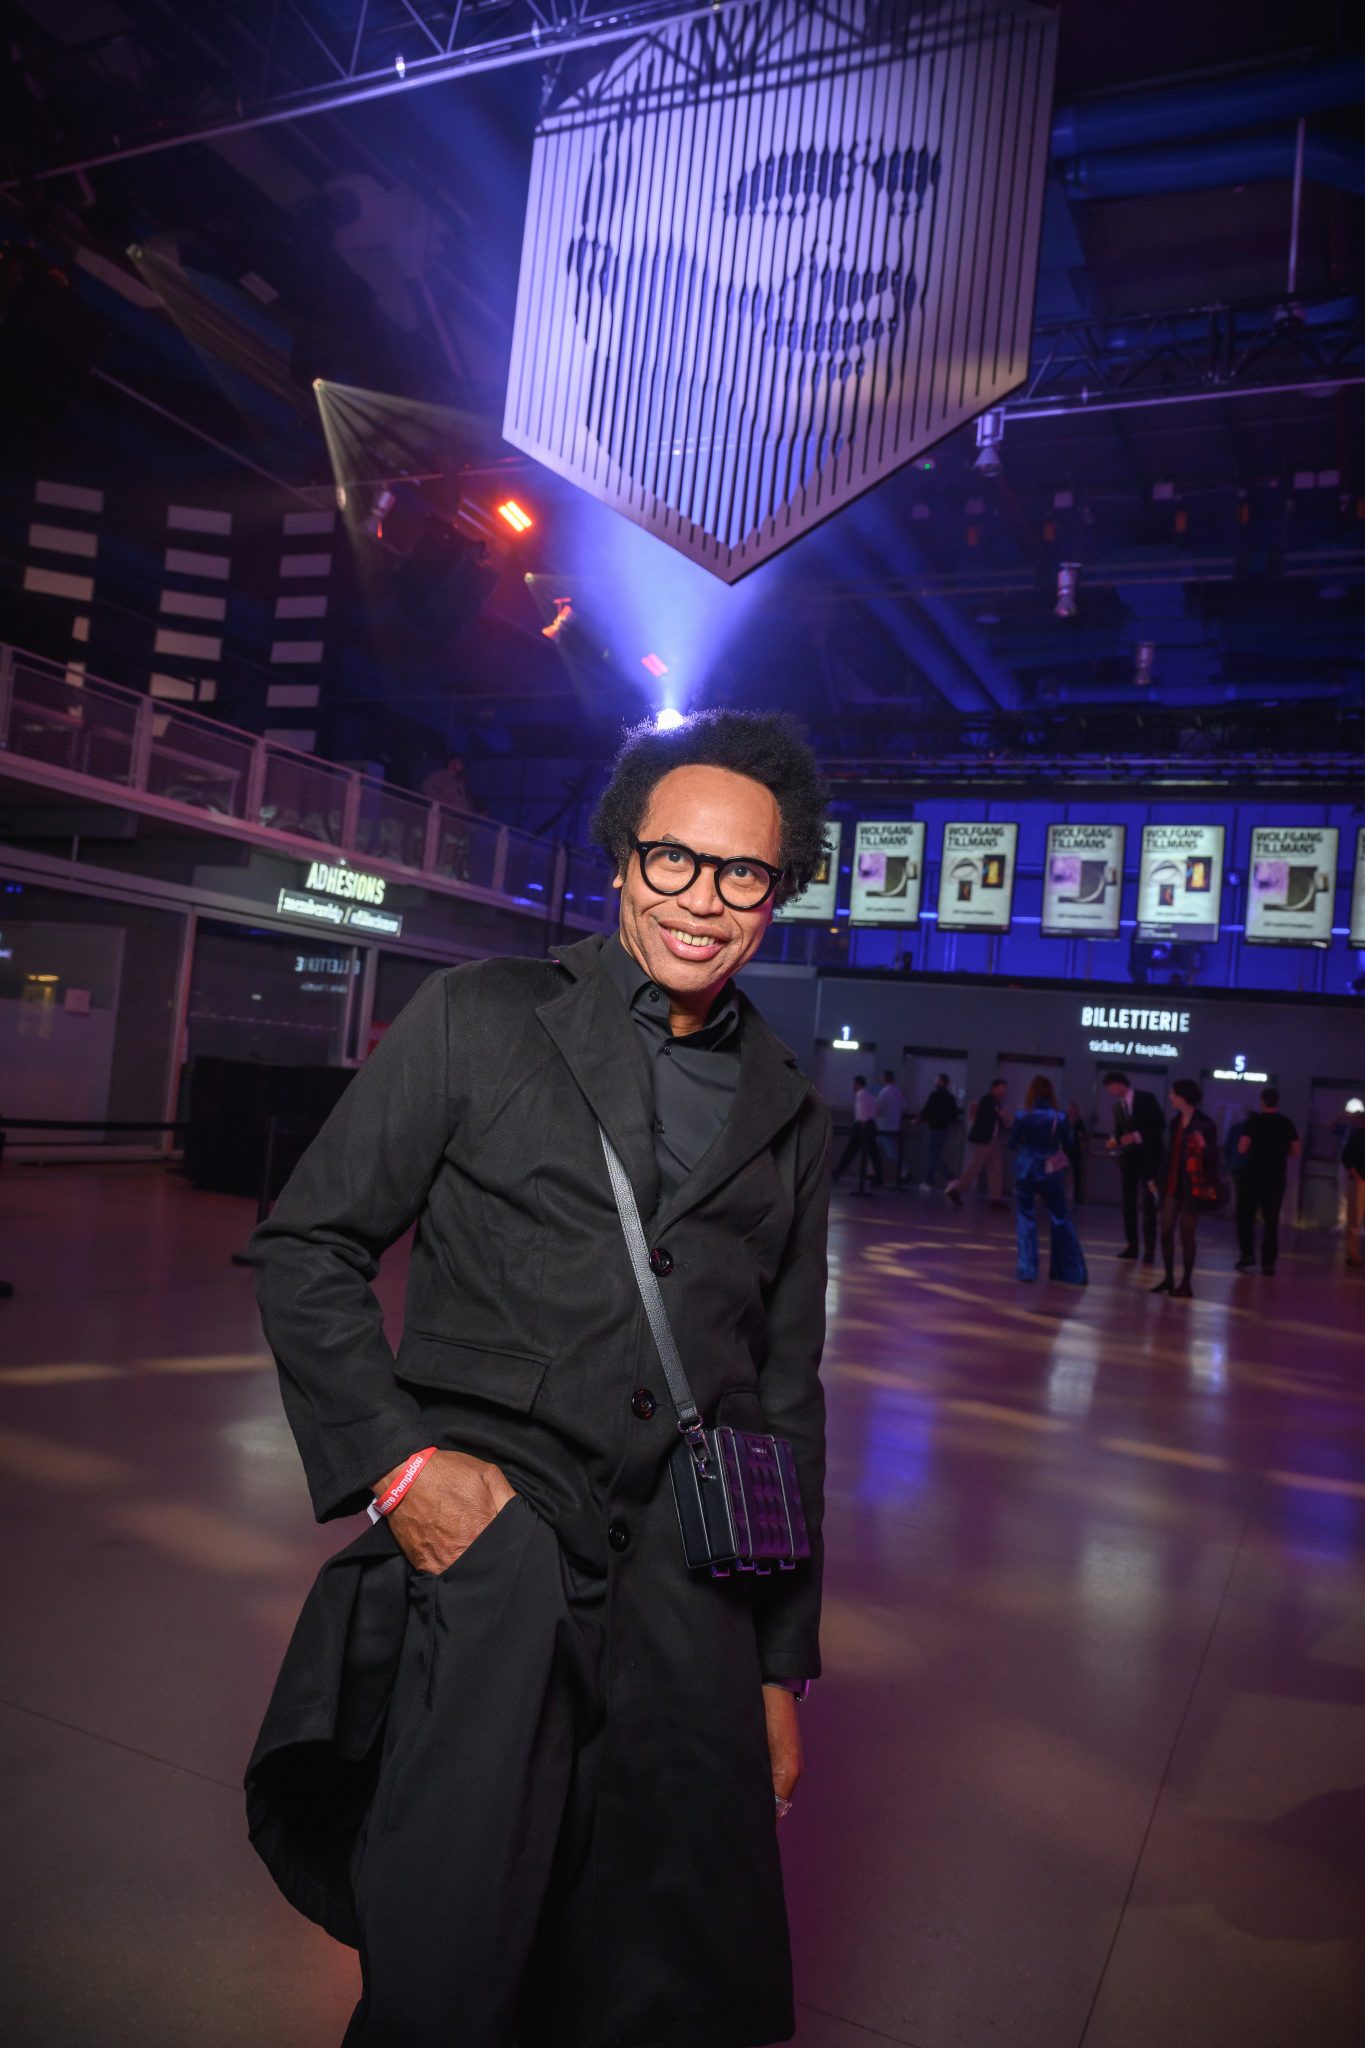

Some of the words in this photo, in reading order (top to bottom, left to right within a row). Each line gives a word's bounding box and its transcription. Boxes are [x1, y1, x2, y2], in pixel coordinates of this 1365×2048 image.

[860, 826, 914, 836] WOLFGANG
[949, 827, 1005, 838] WOLFGANG
[1051, 827, 1113, 839] WOLFGANG
[1146, 828, 1205, 839] WOLFGANG
[859, 835, 908, 846] TILLMANS
[947, 837, 998, 847] TILLMANS
[1256, 832, 1324, 843] WOLFGANG
[1050, 838, 1107, 849] TILLMANS
[1145, 838, 1198, 849] TILLMANS
[1255, 843, 1316, 854] TILLMANS
[1081, 1006, 1190, 1033] BILLETTERIE
[842, 1025, 850, 1041] 1
[1235, 1055, 1246, 1072] 5
[390, 1456, 424, 1498] Pompidou
